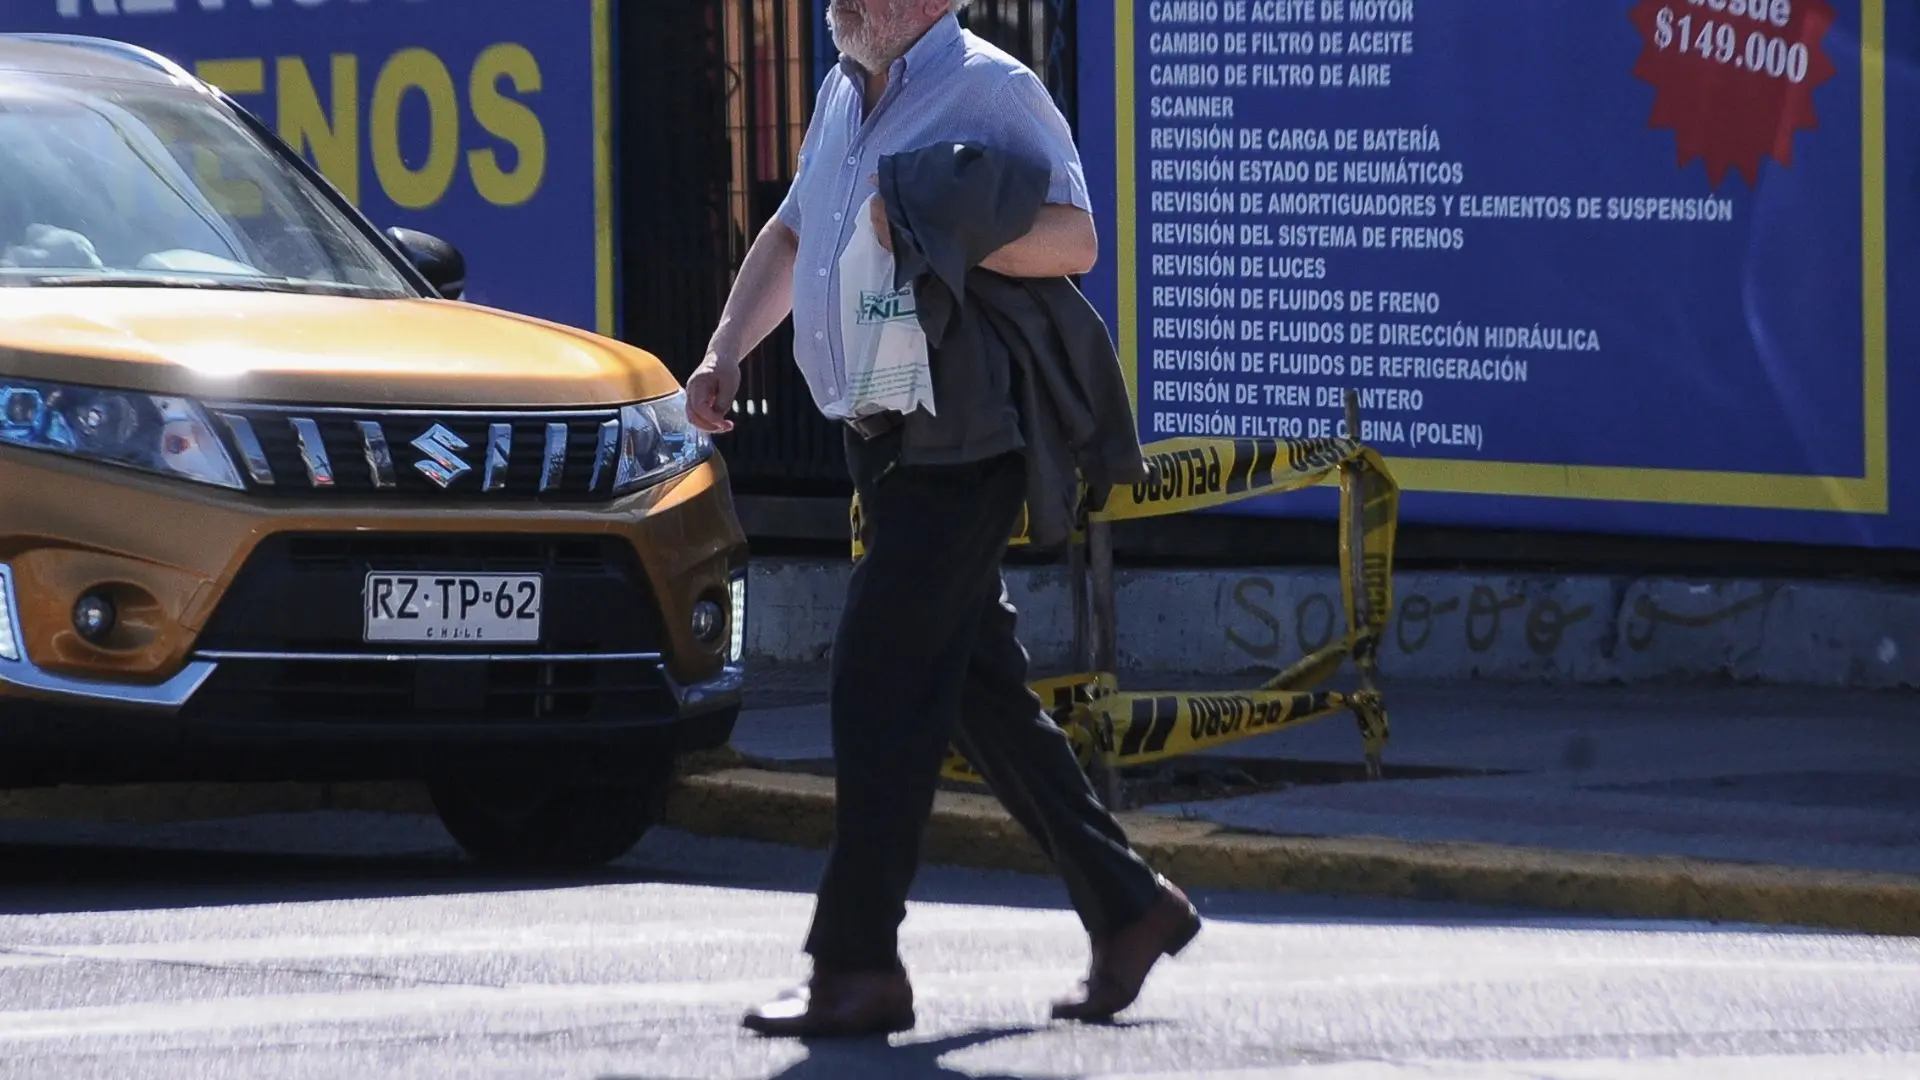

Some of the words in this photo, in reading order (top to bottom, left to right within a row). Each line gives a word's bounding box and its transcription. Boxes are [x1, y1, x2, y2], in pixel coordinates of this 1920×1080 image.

[1149, 0, 1218, 23] CAMBIO
[1223, 0, 1246, 22] DE
[1251, 0, 1315, 22] ACEITE
[1320, 0, 1344, 21] DE
[1349, 0, 1414, 22] MOTOR
[1149, 32, 1219, 54] CAMBIO
[1224, 32, 1247, 54] DE
[1251, 31, 1314, 54] FILTRO
[1319, 31, 1343, 54] DE
[1347, 31, 1413, 54] ACEITE
[1654, 4, 1809, 84] $149.000
[1150, 64, 1219, 86] CAMBIO
[1224, 64, 1247, 86] DE
[1252, 64, 1314, 86] FILTRO
[1319, 64, 1343, 86] DE
[1348, 64, 1391, 87] AIRE
[1150, 96, 1234, 118] SCANNER
[1150, 123, 1234, 150] REVISIÓN
[1239, 128, 1263, 150] DE
[1267, 128, 1330, 151] CARGA
[1334, 129, 1358, 151] DE
[1363, 124, 1440, 151] BATERÍA
[1151, 155, 1234, 182] REVISIÓN
[1239, 160, 1310, 183] ESTADO
[1314, 161, 1338, 183] DE
[1343, 157, 1463, 184] NEUMÁTICOS
[1151, 187, 1235, 213] REVISIÓN
[1240, 192, 1263, 214] DE
[1267, 192, 1436, 217] AMORTIGUADORES
[1442, 195, 1454, 217] Y
[1459, 195, 1571, 219] ELEMENTOS
[1577, 197, 1602, 219] DE
[1607, 193, 1732, 221] SUSPENSIÓN
[1151, 218, 1235, 245] REVISIÓN
[1240, 224, 1274, 246] DEL
[1278, 224, 1357, 247] SISTEMA
[1362, 226, 1386, 248] DE
[1391, 226, 1464, 250] FRENOS
[1152, 250, 1235, 277] REVISIÓN
[1240, 256, 1264, 278] DE
[1268, 256, 1326, 279] LUCES
[1152, 282, 1235, 309] REVISIÓN
[1240, 288, 1264, 309] DE
[1268, 288, 1345, 311] FLUIDOS
[1350, 290, 1373, 312] DE
[1379, 291, 1440, 314] FRENO
[1153, 314, 1235, 340] REVISIÓN
[1240, 320, 1264, 341] DE
[1269, 320, 1345, 344] FLUIDOS
[1350, 322, 1374, 345] DE
[1379, 320, 1479, 348] DIRECCIÓN
[1485, 321, 1600, 351] HIDRÁULICA
[1153, 346, 1235, 372] REVISIÓN
[1241, 352, 1264, 373] DE
[1269, 352, 1345, 376] FLUIDOS
[1350, 355, 1374, 377] DE
[1379, 353, 1527, 382] REFRIGERACIÓN
[1153, 378, 1230, 404] REVISÓN
[1235, 383, 1258, 405] DE
[1262, 384, 1310, 406] TREN
[1154, 411, 1235, 435] REVISIÓN
[1241, 416, 1302, 438] FILTRO
[1308, 418, 1331, 439] DE
[1337, 419, 1405, 442] CBINA
[1410, 422, 1483, 450] (POLEN)
[426, 626, 484, 639] CHILE
[1187, 695, 1283, 739] PELIGRO
